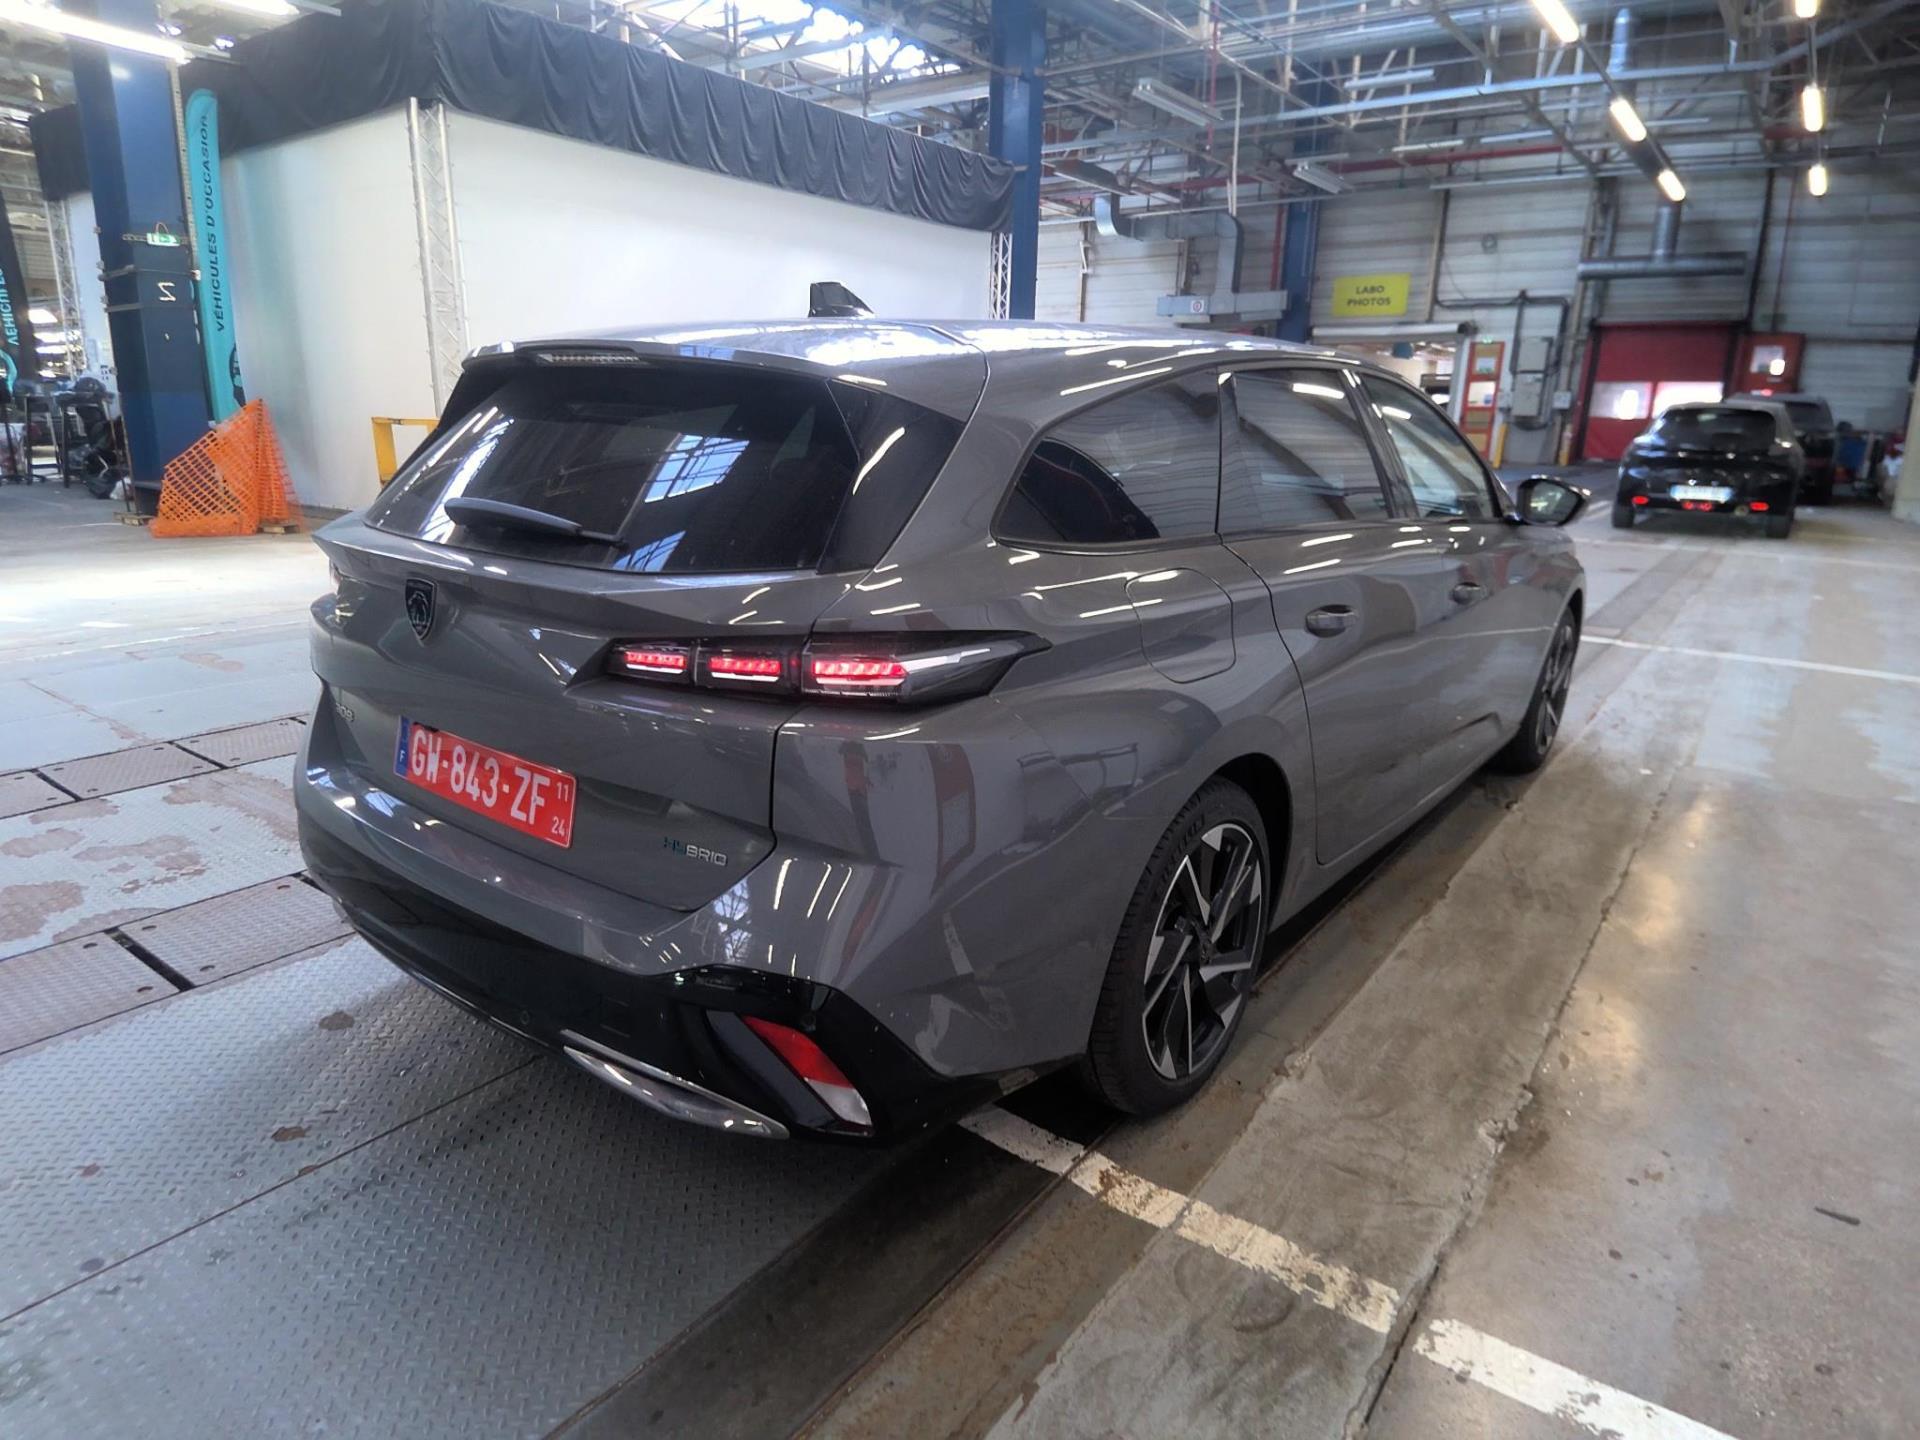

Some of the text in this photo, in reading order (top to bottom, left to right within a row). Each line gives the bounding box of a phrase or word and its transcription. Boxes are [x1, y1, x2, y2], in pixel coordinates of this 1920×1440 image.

[207, 232, 226, 332] VÉHICULES
[1355, 285, 1385, 295] LABO
[1346, 296, 1391, 307] PHOTOS
[400, 750, 406, 762] F
[411, 729, 550, 825] GW-843-ZF
[556, 781, 569, 803] 11
[551, 815, 566, 836] 24
